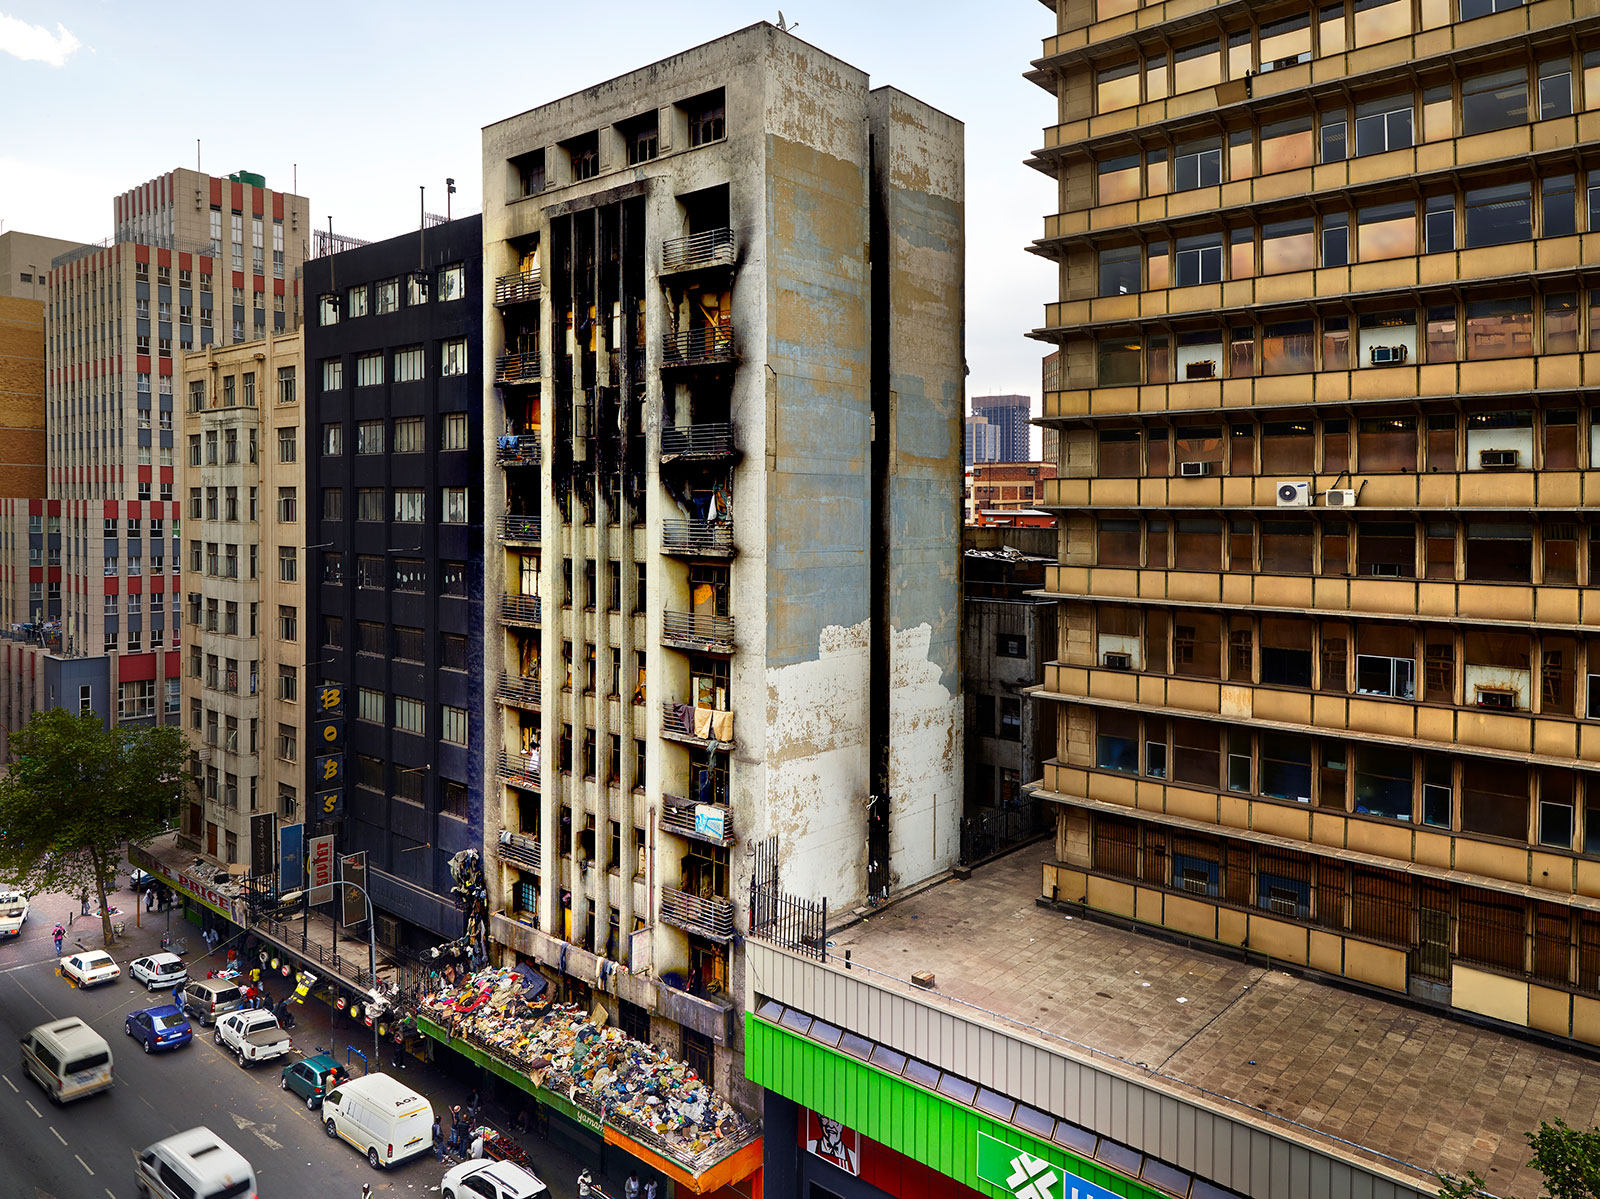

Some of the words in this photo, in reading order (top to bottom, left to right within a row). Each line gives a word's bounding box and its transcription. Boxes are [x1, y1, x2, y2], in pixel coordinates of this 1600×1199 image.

[320, 688, 341, 814] BOB'S
[256, 817, 267, 840] boy
[177, 873, 230, 911] PRICE
